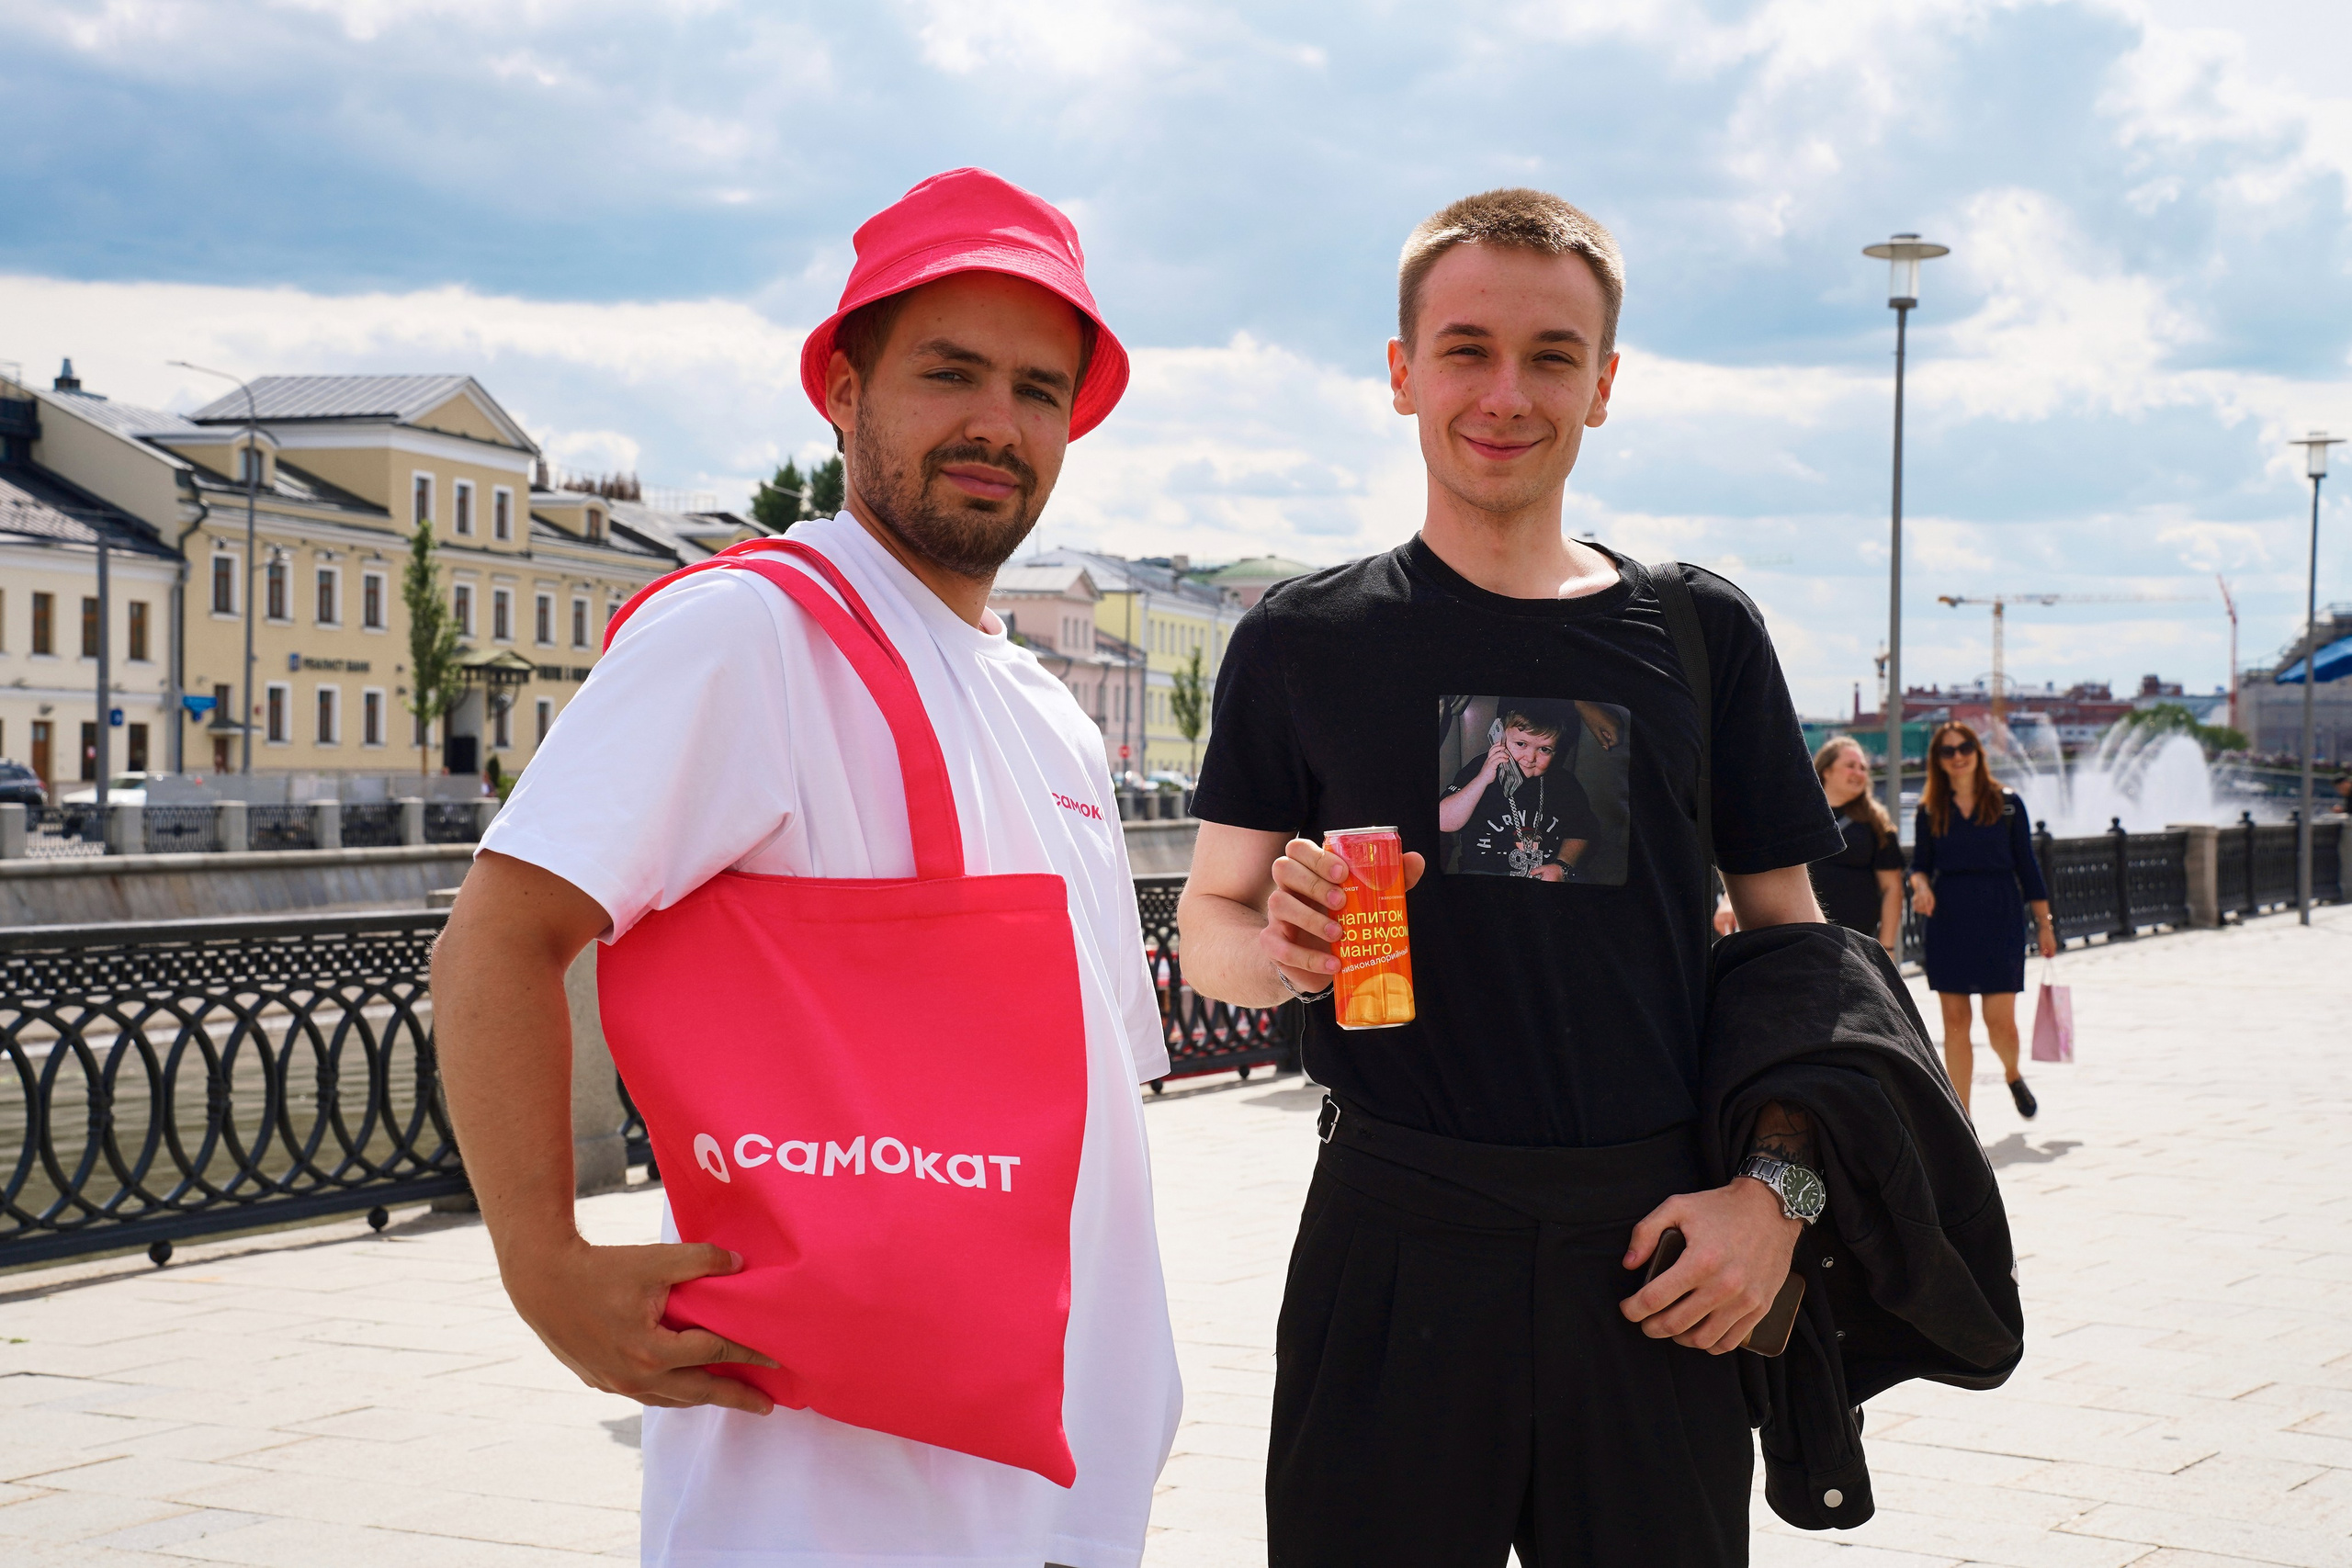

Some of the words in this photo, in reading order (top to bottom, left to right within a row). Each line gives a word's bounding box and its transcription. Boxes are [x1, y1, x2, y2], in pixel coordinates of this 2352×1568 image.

[1052, 792, 1104, 820] самок
[1337, 909, 1404, 925] напиток
[1340, 929, 1358, 942] со
[1340, 942, 1393, 958] манго
[733, 1133, 1021, 1192] самокат
